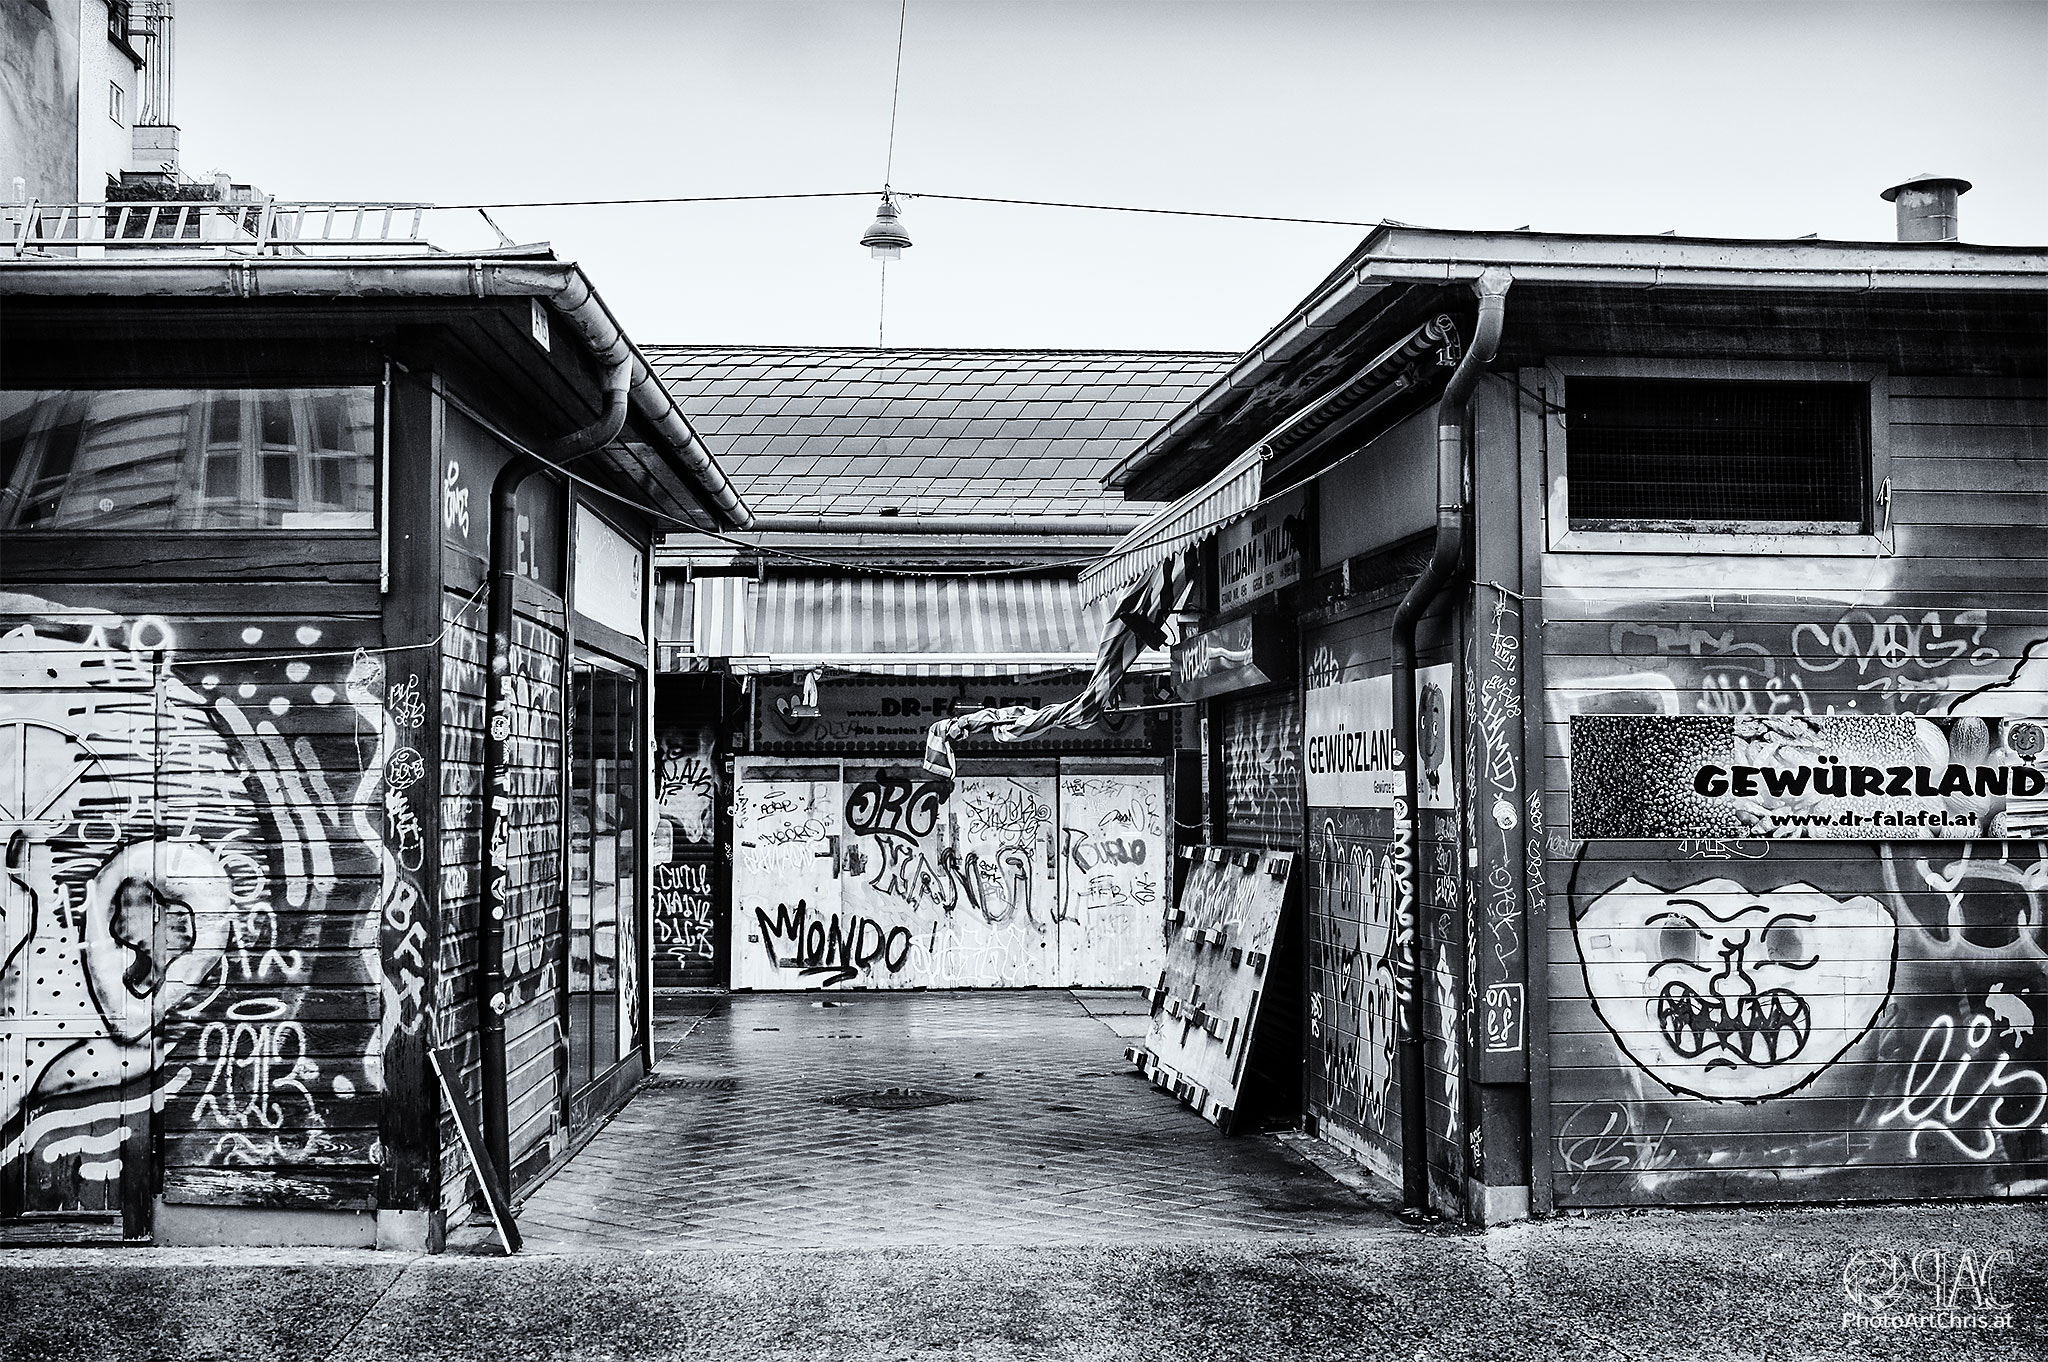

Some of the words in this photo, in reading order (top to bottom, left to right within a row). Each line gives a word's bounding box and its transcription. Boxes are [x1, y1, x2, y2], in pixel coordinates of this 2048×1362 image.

[1220, 538, 1257, 588] WILDAM
[1308, 723, 1394, 775] GEWÜRZLAN
[1693, 755, 2046, 798] GEWÜRZLAND
[1770, 811, 1978, 827] www.dr-falafel.at
